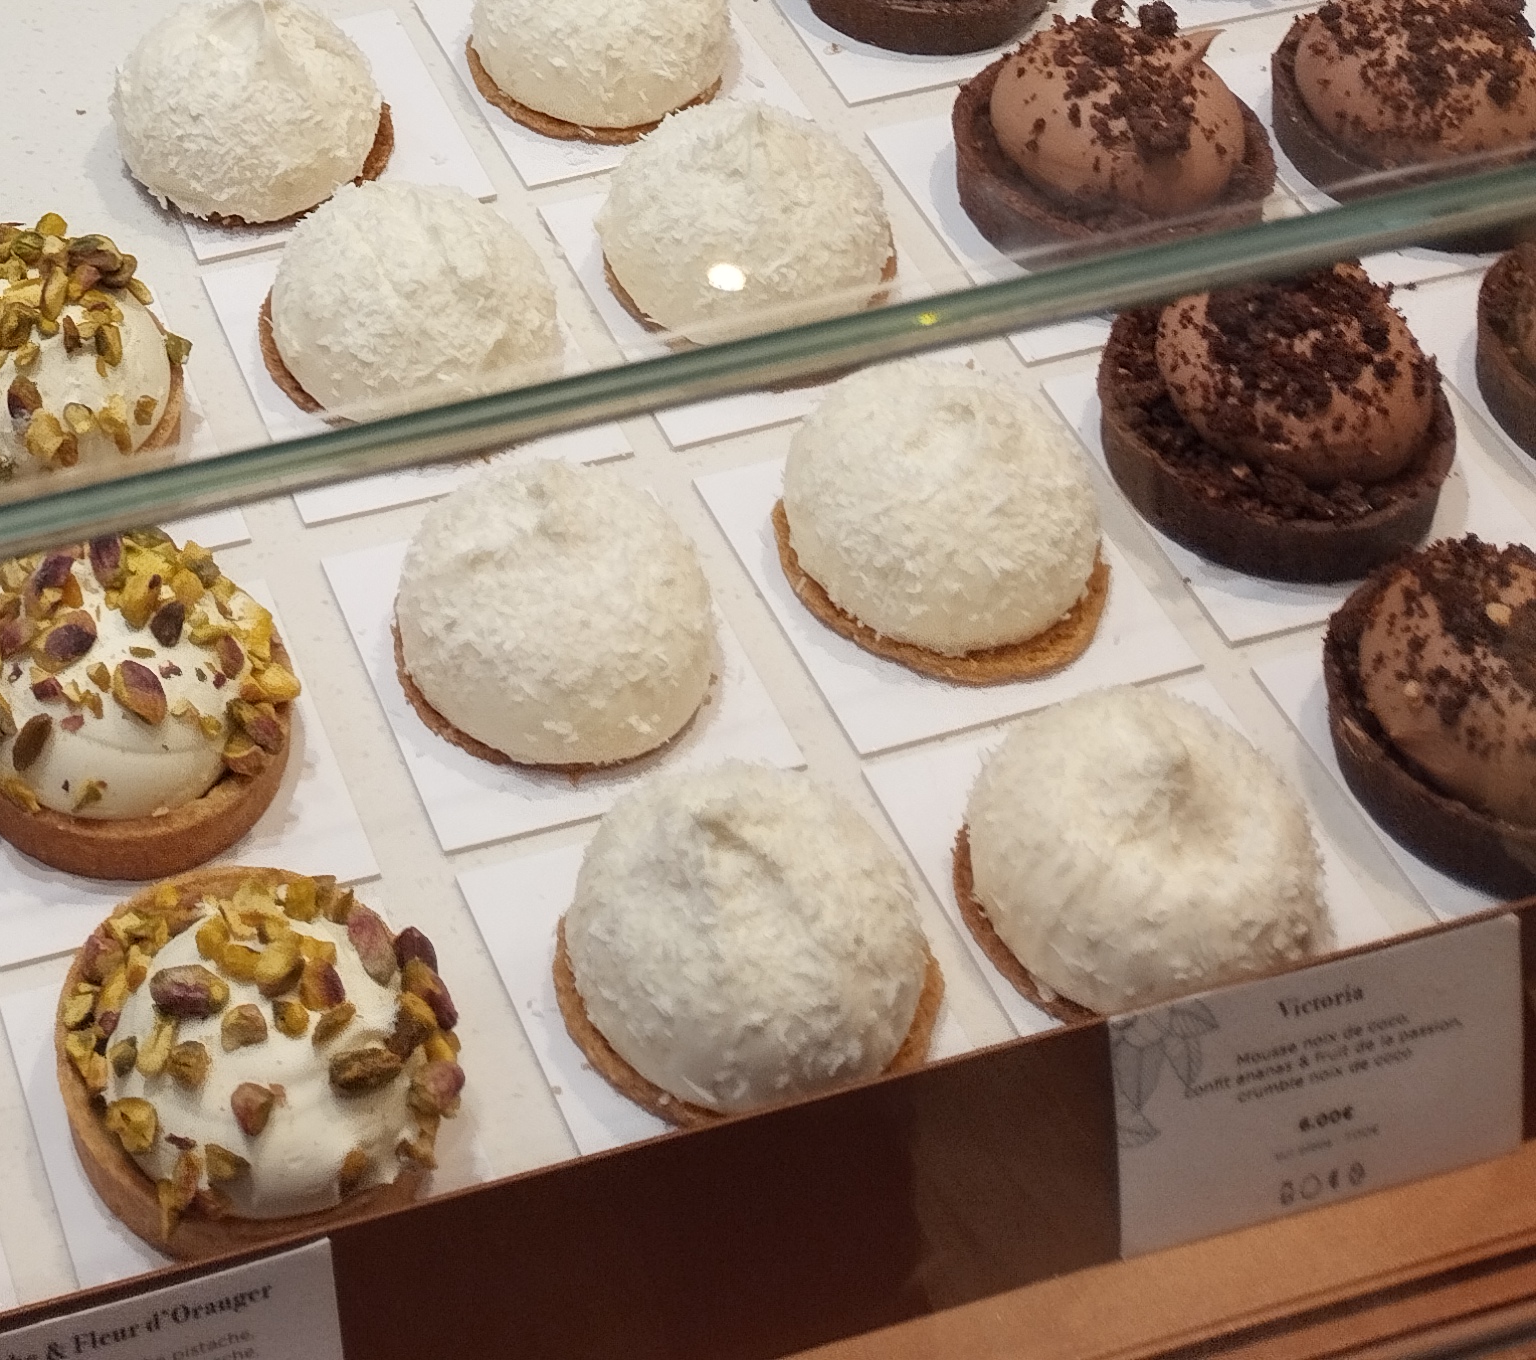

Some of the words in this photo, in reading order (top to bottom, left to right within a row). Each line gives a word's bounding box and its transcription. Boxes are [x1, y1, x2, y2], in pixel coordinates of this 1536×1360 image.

[1277, 983, 1363, 1018] Victoria
[1236, 1042, 1297, 1066] Mousse
[1303, 1032, 1337, 1049] noix
[1343, 1023, 1363, 1040] de
[1236, 1061, 1292, 1085] ananas
[1355, 1040, 1375, 1054] de
[1309, 1067, 1343, 1082] noix
[1349, 1058, 1369, 1074] de
[46, 1340, 67, 1360] &
[74, 1322, 138, 1354] Fleur
[145, 1284, 273, 1332] d'Oranger
